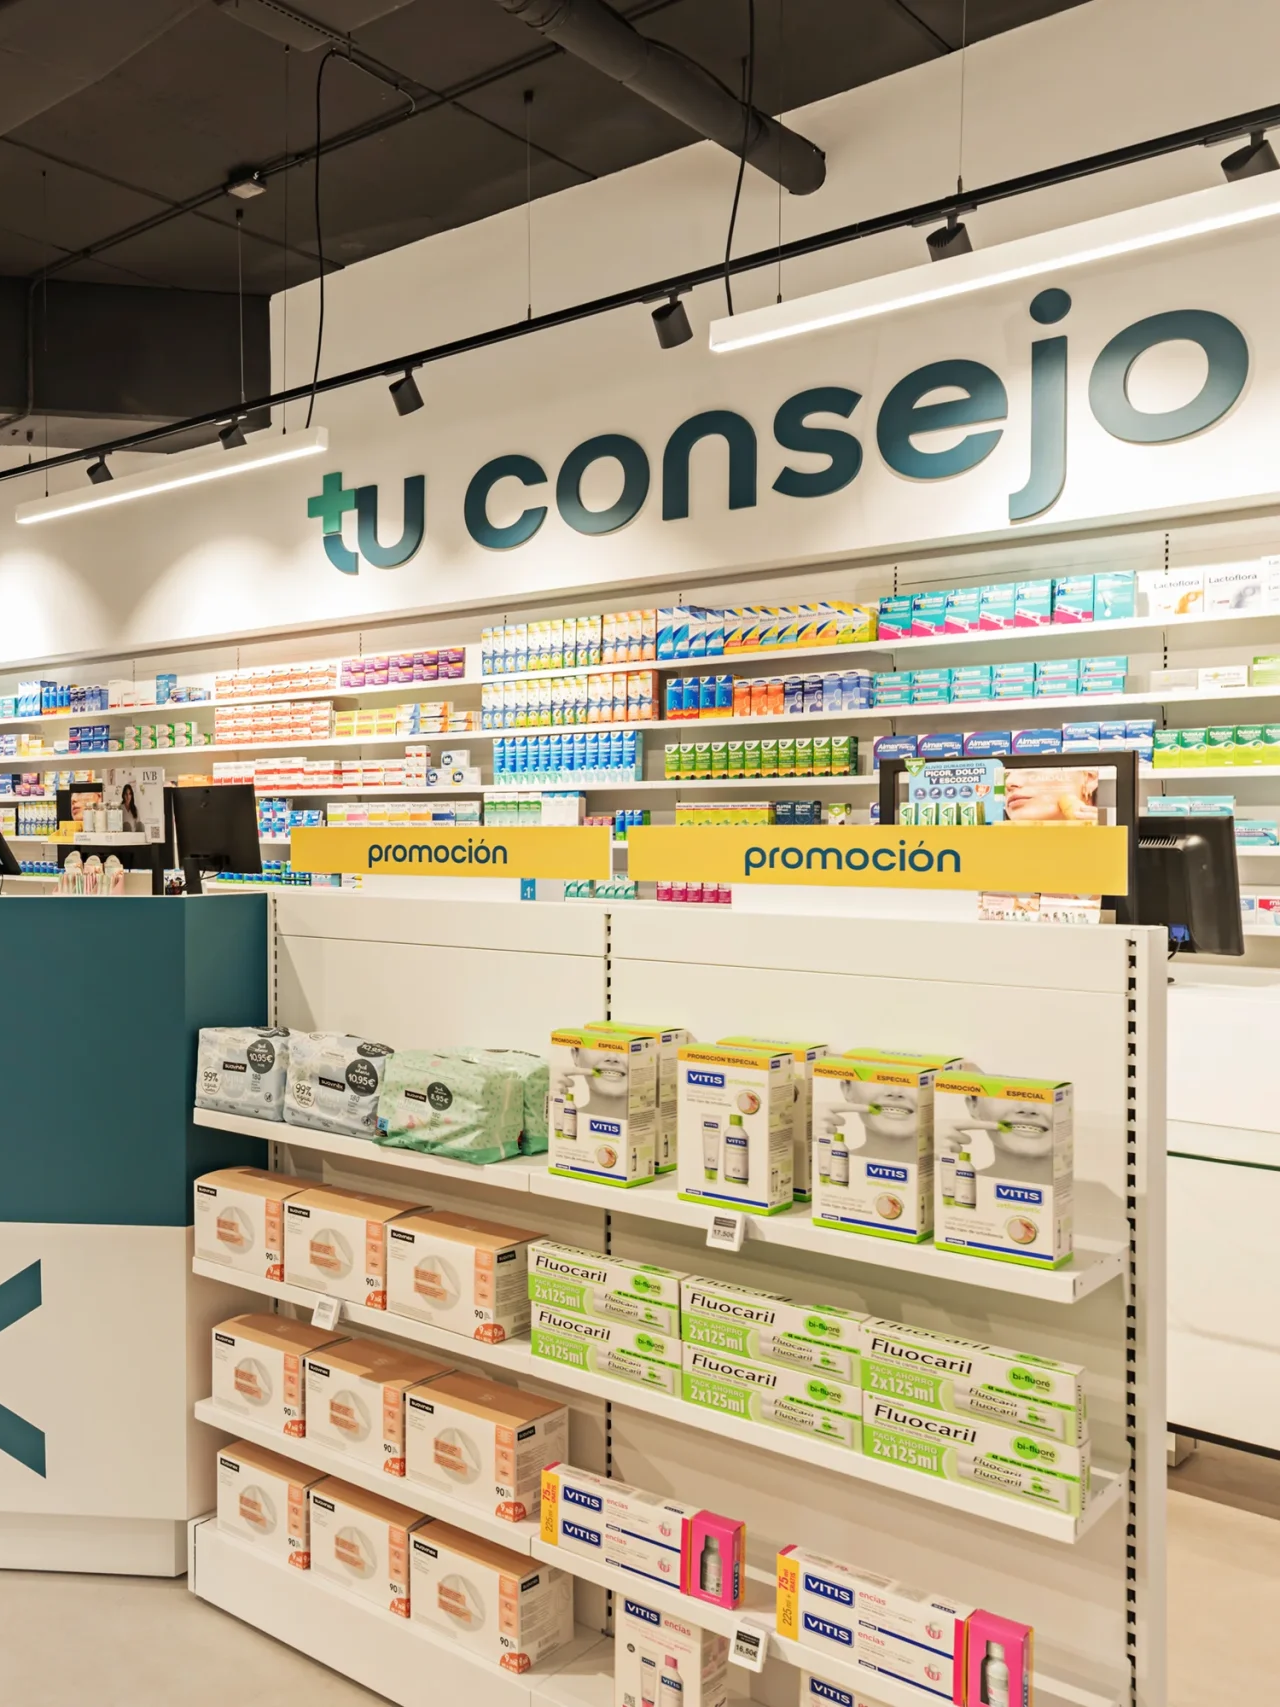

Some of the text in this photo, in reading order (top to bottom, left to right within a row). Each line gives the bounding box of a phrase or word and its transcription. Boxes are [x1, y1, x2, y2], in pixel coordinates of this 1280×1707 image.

[307, 287, 1251, 576] tu consejo
[1154, 579, 1200, 589] Lactoflora
[1209, 573, 1257, 584] Lactoflora
[142, 771, 157, 781] IVB
[939, 776, 979, 784] ESCOZOR
[956, 768, 985, 776] DOLOR
[368, 838, 507, 868] promoción
[744, 839, 961, 876] promoción
[598, 1042, 624, 1050] ESPECIAL
[727, 1058, 758, 1066] ESPECIAL
[203, 1072, 218, 1082] 99%
[689, 1073, 722, 1084] VITIS
[814, 1068, 911, 1084] PROMOCIÓN ESPECIAL
[295, 1084, 312, 1096] 99%
[936, 1083, 1045, 1100] PROMOCIÓN ESPECIAL
[591, 1123, 619, 1133] VITIS
[869, 1167, 907, 1179] VITIS
[999, 1188, 1039, 1201] VITIS
[536, 1255, 607, 1283] Fluocaril
[365, 1277, 374, 1286] 90
[535, 1285, 580, 1309] 2x125ml
[474, 1309, 483, 1319] 90
[605, 1304, 638, 1317] Fluocaril
[690, 1293, 775, 1324] Fluocaril
[540, 1311, 611, 1340] Fluocaril
[689, 1325, 743, 1352] 2x125ml
[538, 1340, 584, 1365] 2x125ml
[773, 1346, 813, 1361] Fluocaril
[871, 1337, 972, 1374] Fluocaril
[608, 1361, 641, 1376] Fluocaril
[692, 1353, 777, 1387] Fluocaril
[870, 1365, 934, 1387] PACK AHORRO
[690, 1379, 712, 1390] PACK
[870, 1372, 934, 1403] 2x125ml
[1012, 1371, 1051, 1388] bi-fluoré
[690, 1385, 745, 1414] 2x125ml
[970, 1399, 1017, 1417] Fluocaril
[774, 1410, 814, 1426] Fluocaril
[874, 1404, 977, 1443] Fluocaril
[383, 1443, 392, 1454] 90
[873, 1431, 938, 1454] PACK AHORRO
[1016, 1442, 1055, 1459] bi-fluoré
[873, 1439, 937, 1472] 2x125ml
[973, 1468, 1022, 1488] Fluocaril
[496, 1486, 504, 1496] 90
[565, 1490, 599, 1508] VITIS
[564, 1524, 599, 1543] VITIS
[779, 1576, 789, 1590] 75
[807, 1578, 850, 1602] VITIS
[627, 1603, 691, 1636] VITIS encias
[782, 1609, 792, 1626] 225
[807, 1617, 850, 1641] VITIS
[499, 1636, 509, 1647] 90
[662, 1678, 680, 1689] VITIS
[813, 1682, 851, 1704] VITIS
